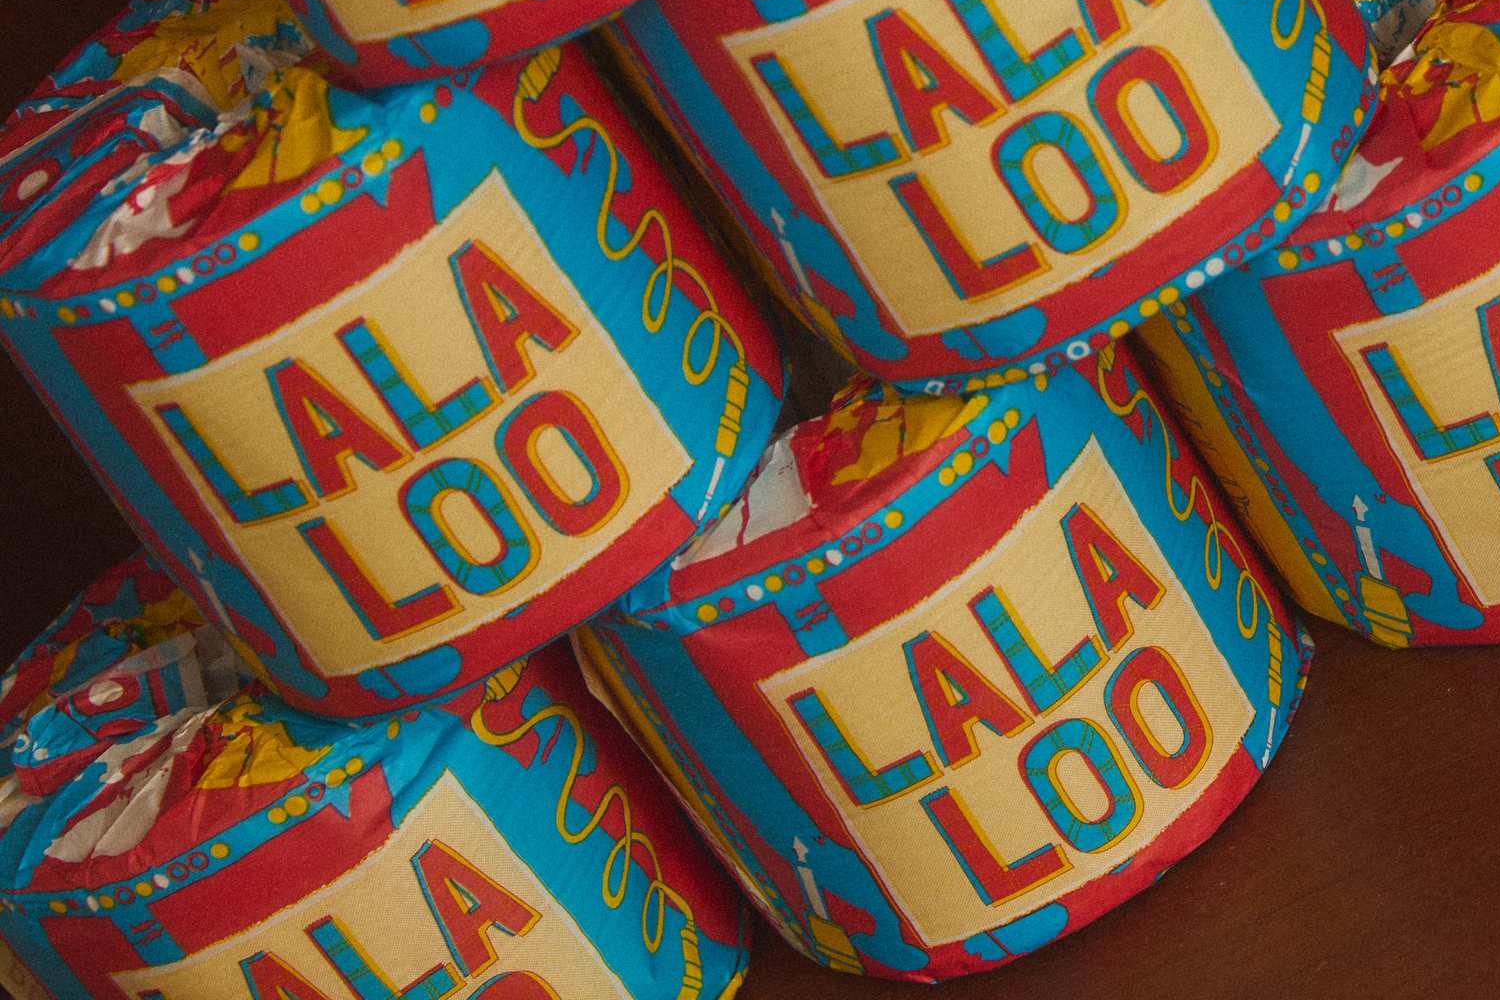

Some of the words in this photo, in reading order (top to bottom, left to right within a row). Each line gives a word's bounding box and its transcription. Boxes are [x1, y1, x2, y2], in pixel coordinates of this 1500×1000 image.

[888, 43, 1221, 304] LOO
[154, 237, 581, 528] LALA
[294, 390, 631, 643] LOO
[786, 501, 1168, 810] LALA
[919, 645, 1214, 908] LOO
[139, 838, 543, 1000] LA
